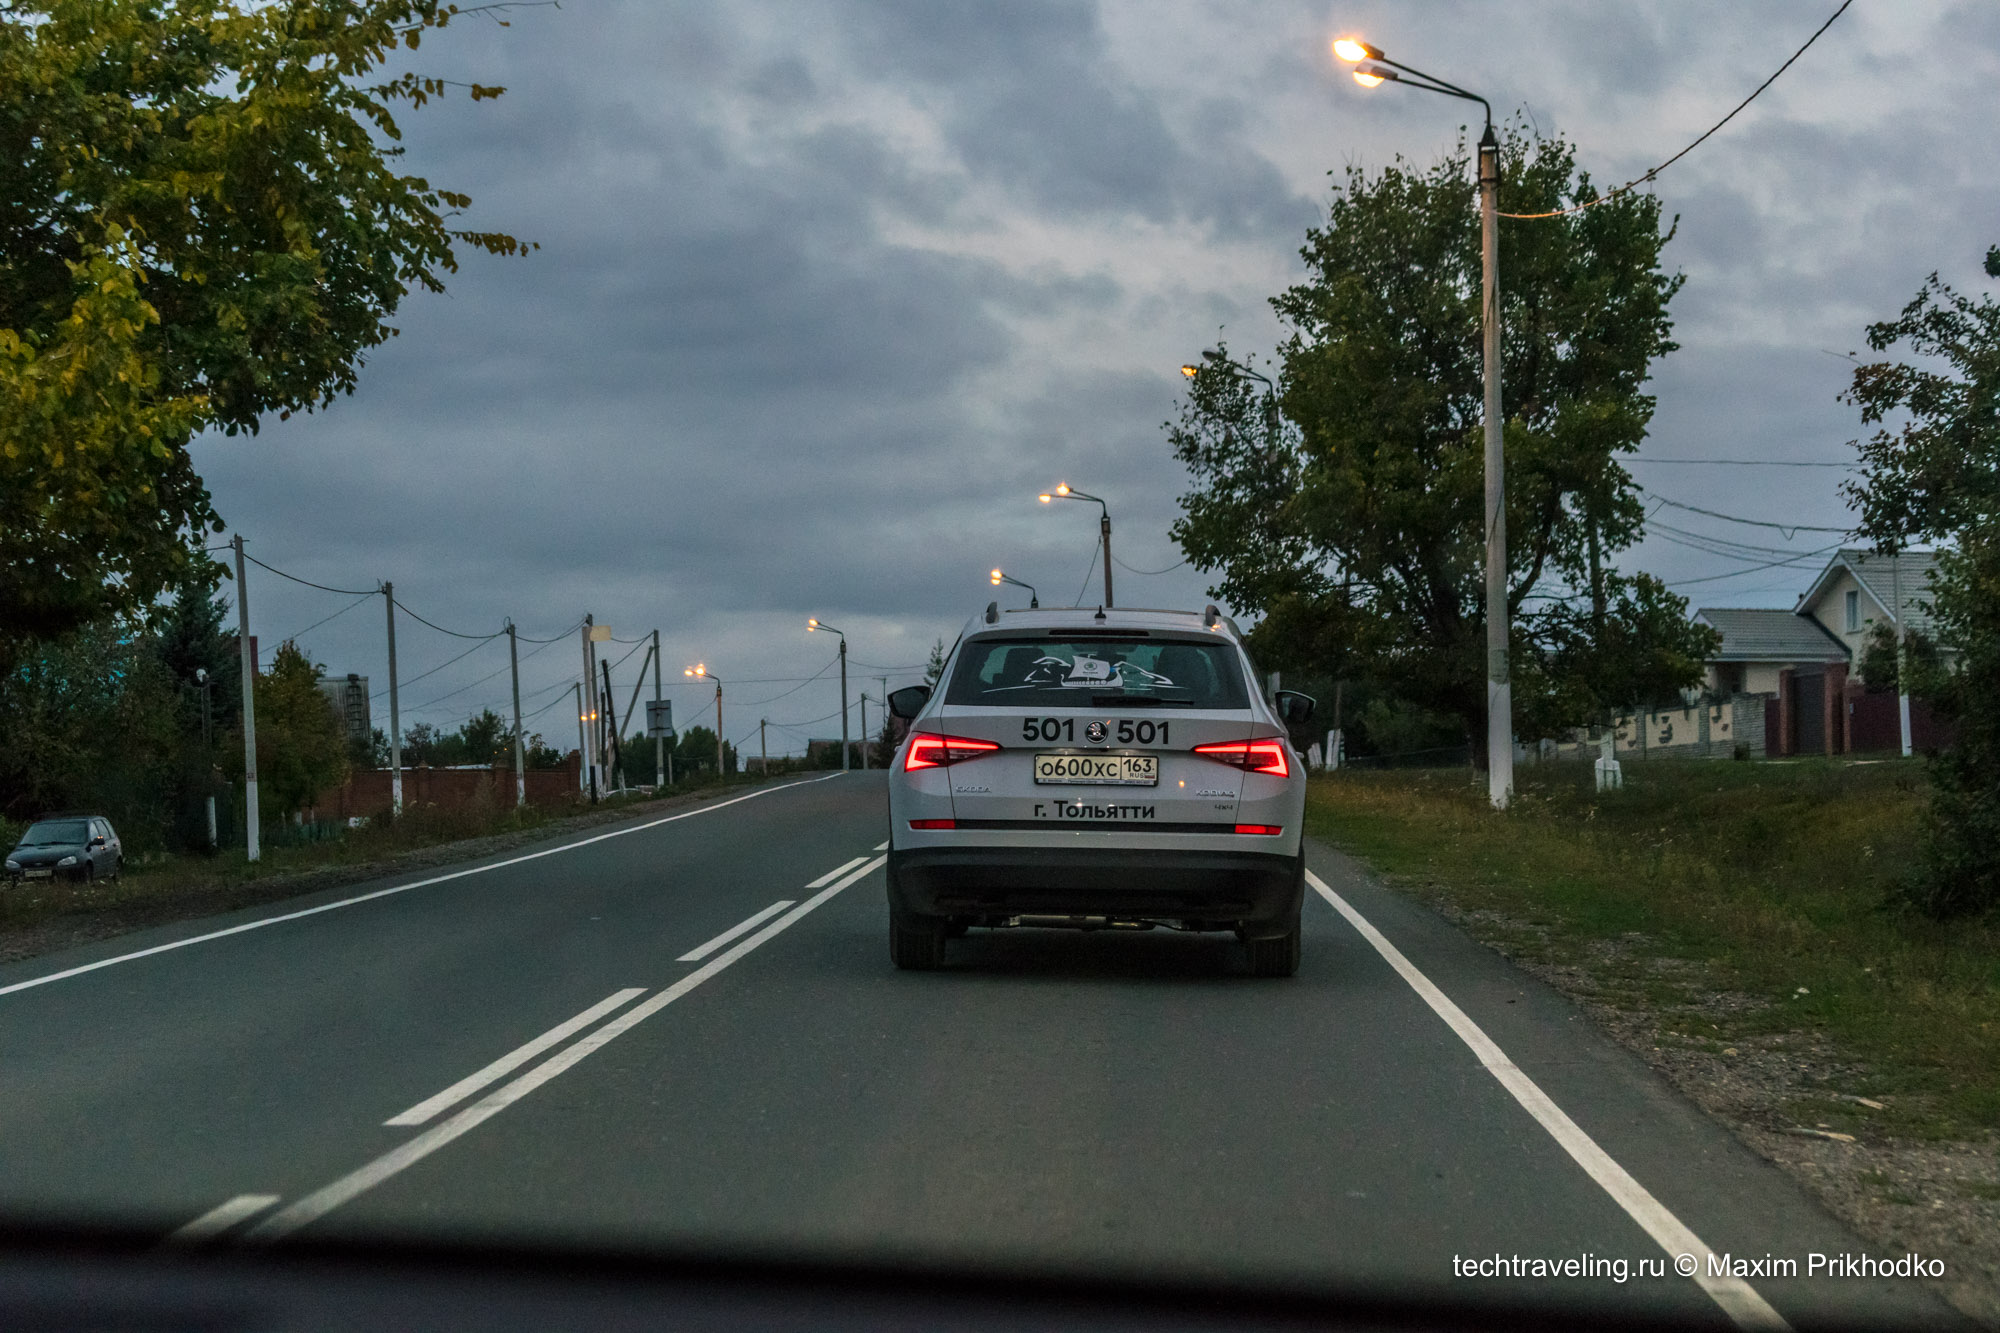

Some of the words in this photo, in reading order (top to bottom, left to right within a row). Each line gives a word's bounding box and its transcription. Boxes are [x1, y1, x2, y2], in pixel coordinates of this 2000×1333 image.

[1022, 717, 1074, 742] 501
[1117, 719, 1169, 744] 501
[1123, 758, 1152, 773] 163
[1034, 804, 1047, 817] г.
[1053, 800, 1155, 819] Тольятти
